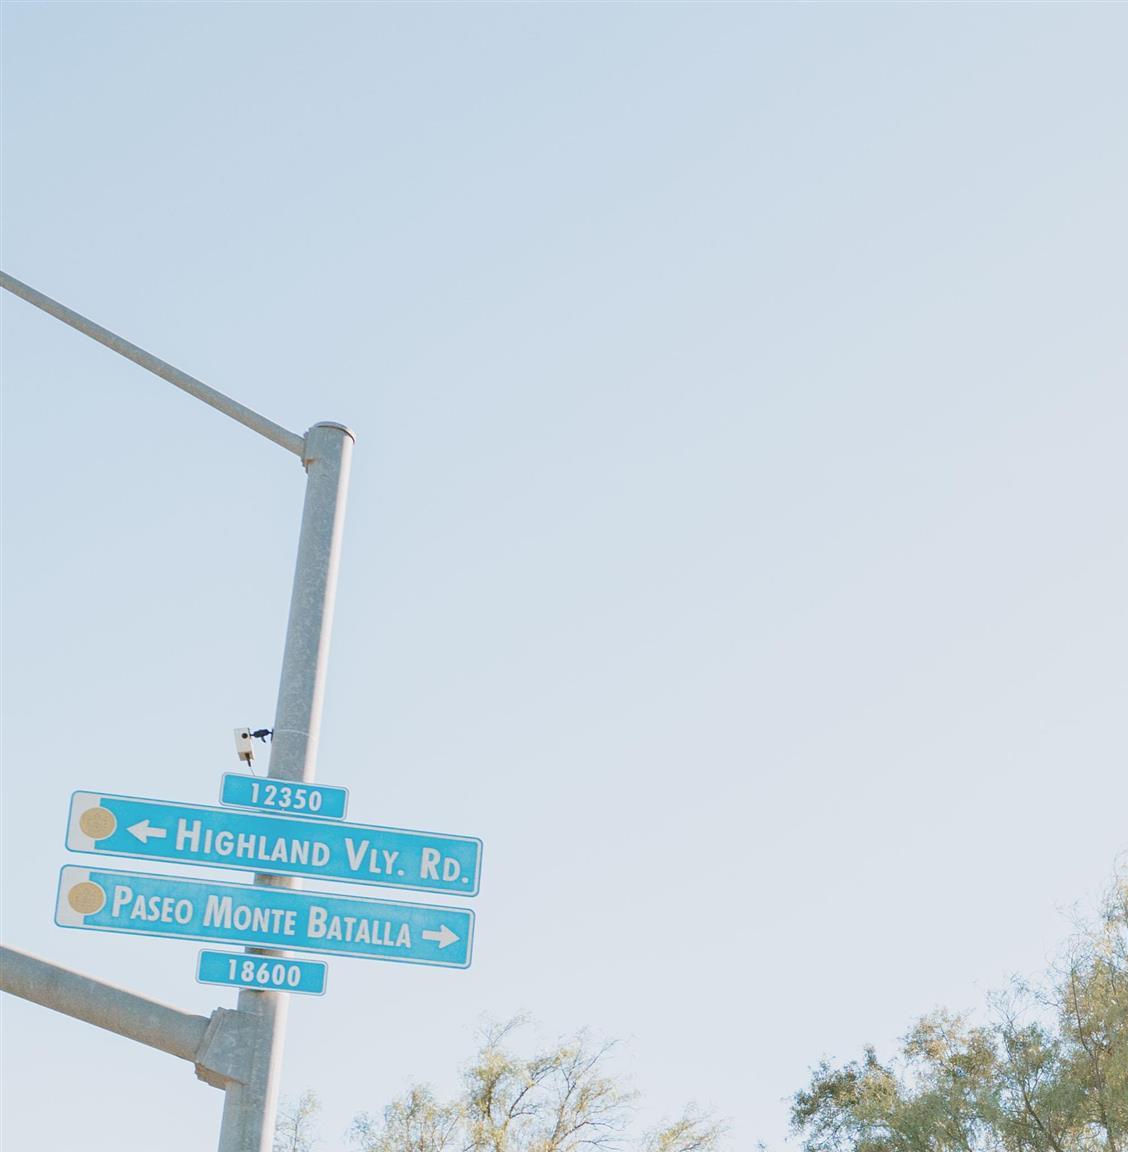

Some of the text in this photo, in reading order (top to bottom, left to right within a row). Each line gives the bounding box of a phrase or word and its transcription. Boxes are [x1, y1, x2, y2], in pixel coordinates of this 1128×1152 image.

[251, 782, 322, 812] 12350
[175, 817, 469, 884] HIGHLAND VLY. RD.
[111, 884, 412, 949] PASEO MONTE BATALLA
[228, 958, 301, 987] 18600
